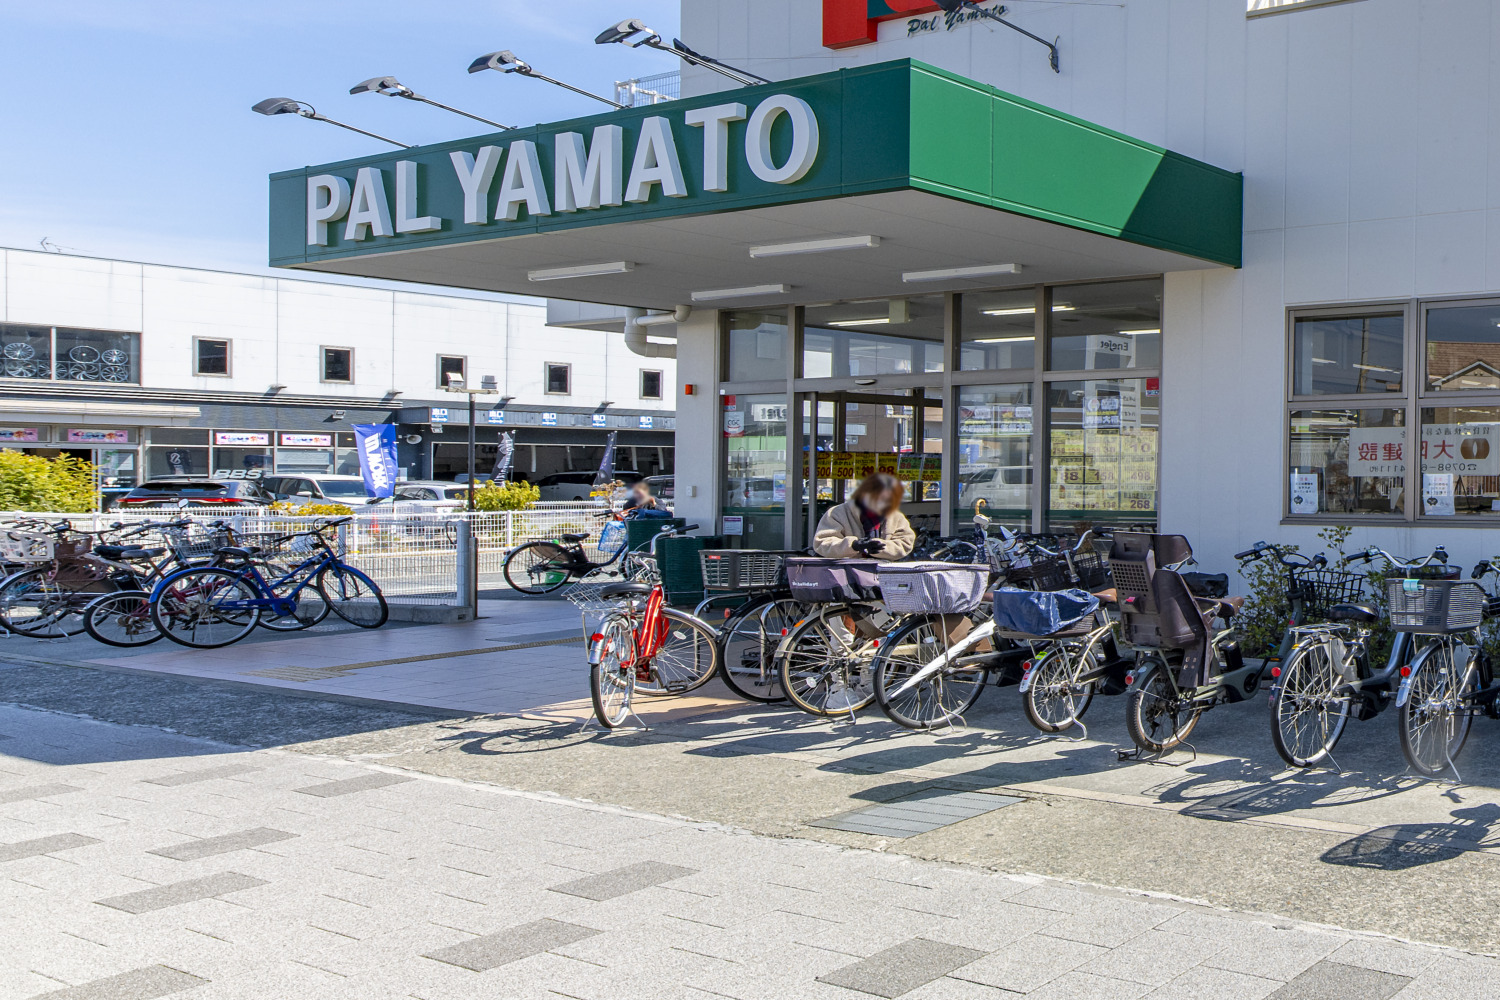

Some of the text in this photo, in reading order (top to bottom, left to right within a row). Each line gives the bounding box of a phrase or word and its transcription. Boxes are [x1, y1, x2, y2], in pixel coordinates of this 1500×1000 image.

[907, 15, 939, 37] Pal
[307, 94, 819, 247] PAL YAMATO
[213, 469, 262, 479] BBS
[837, 467, 854, 477] 500
[1130, 499, 1150, 509] 268
